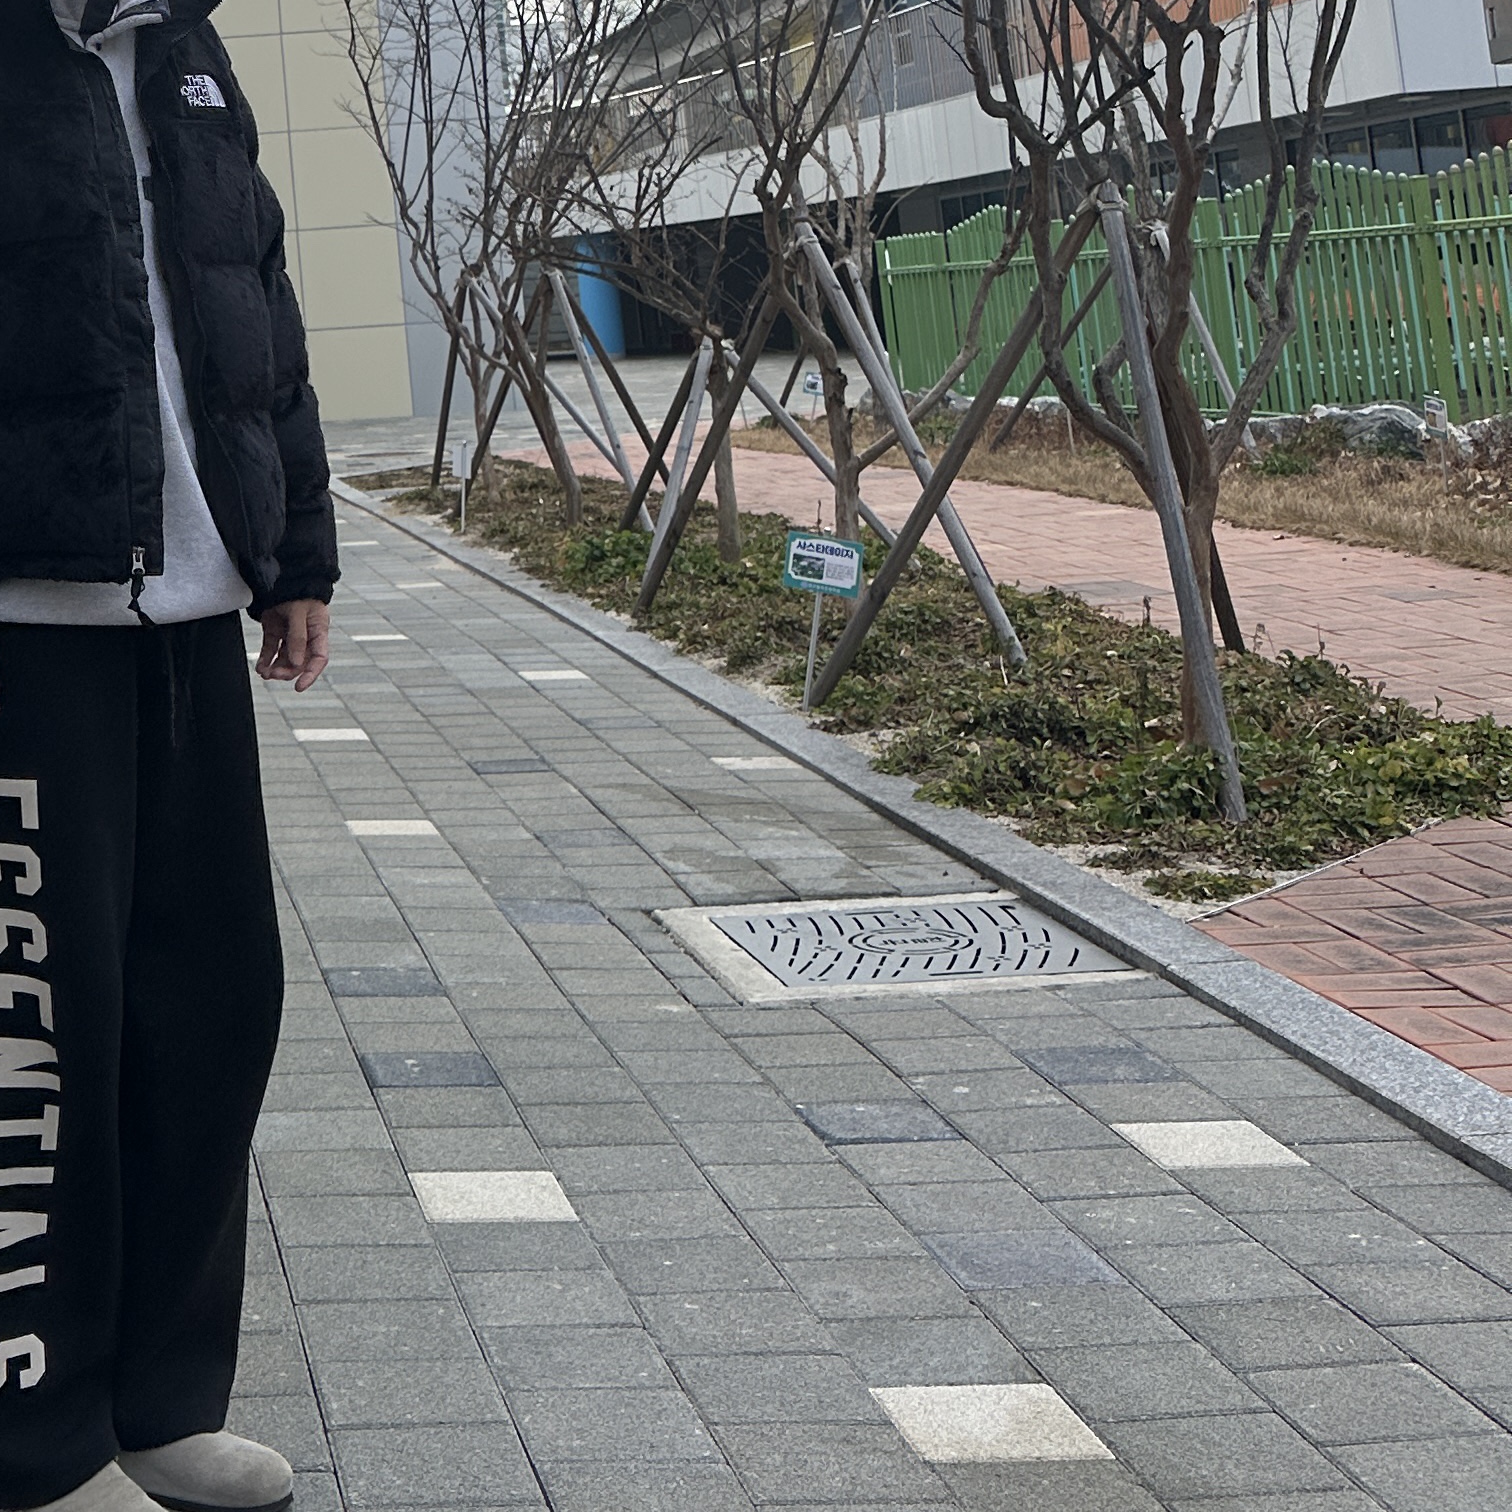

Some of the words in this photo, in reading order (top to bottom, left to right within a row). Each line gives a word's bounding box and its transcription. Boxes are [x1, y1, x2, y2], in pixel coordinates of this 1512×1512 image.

[184, 74, 206, 86] THE
[180, 85, 209, 97] ORTH
[187, 96, 212, 108] FACE
